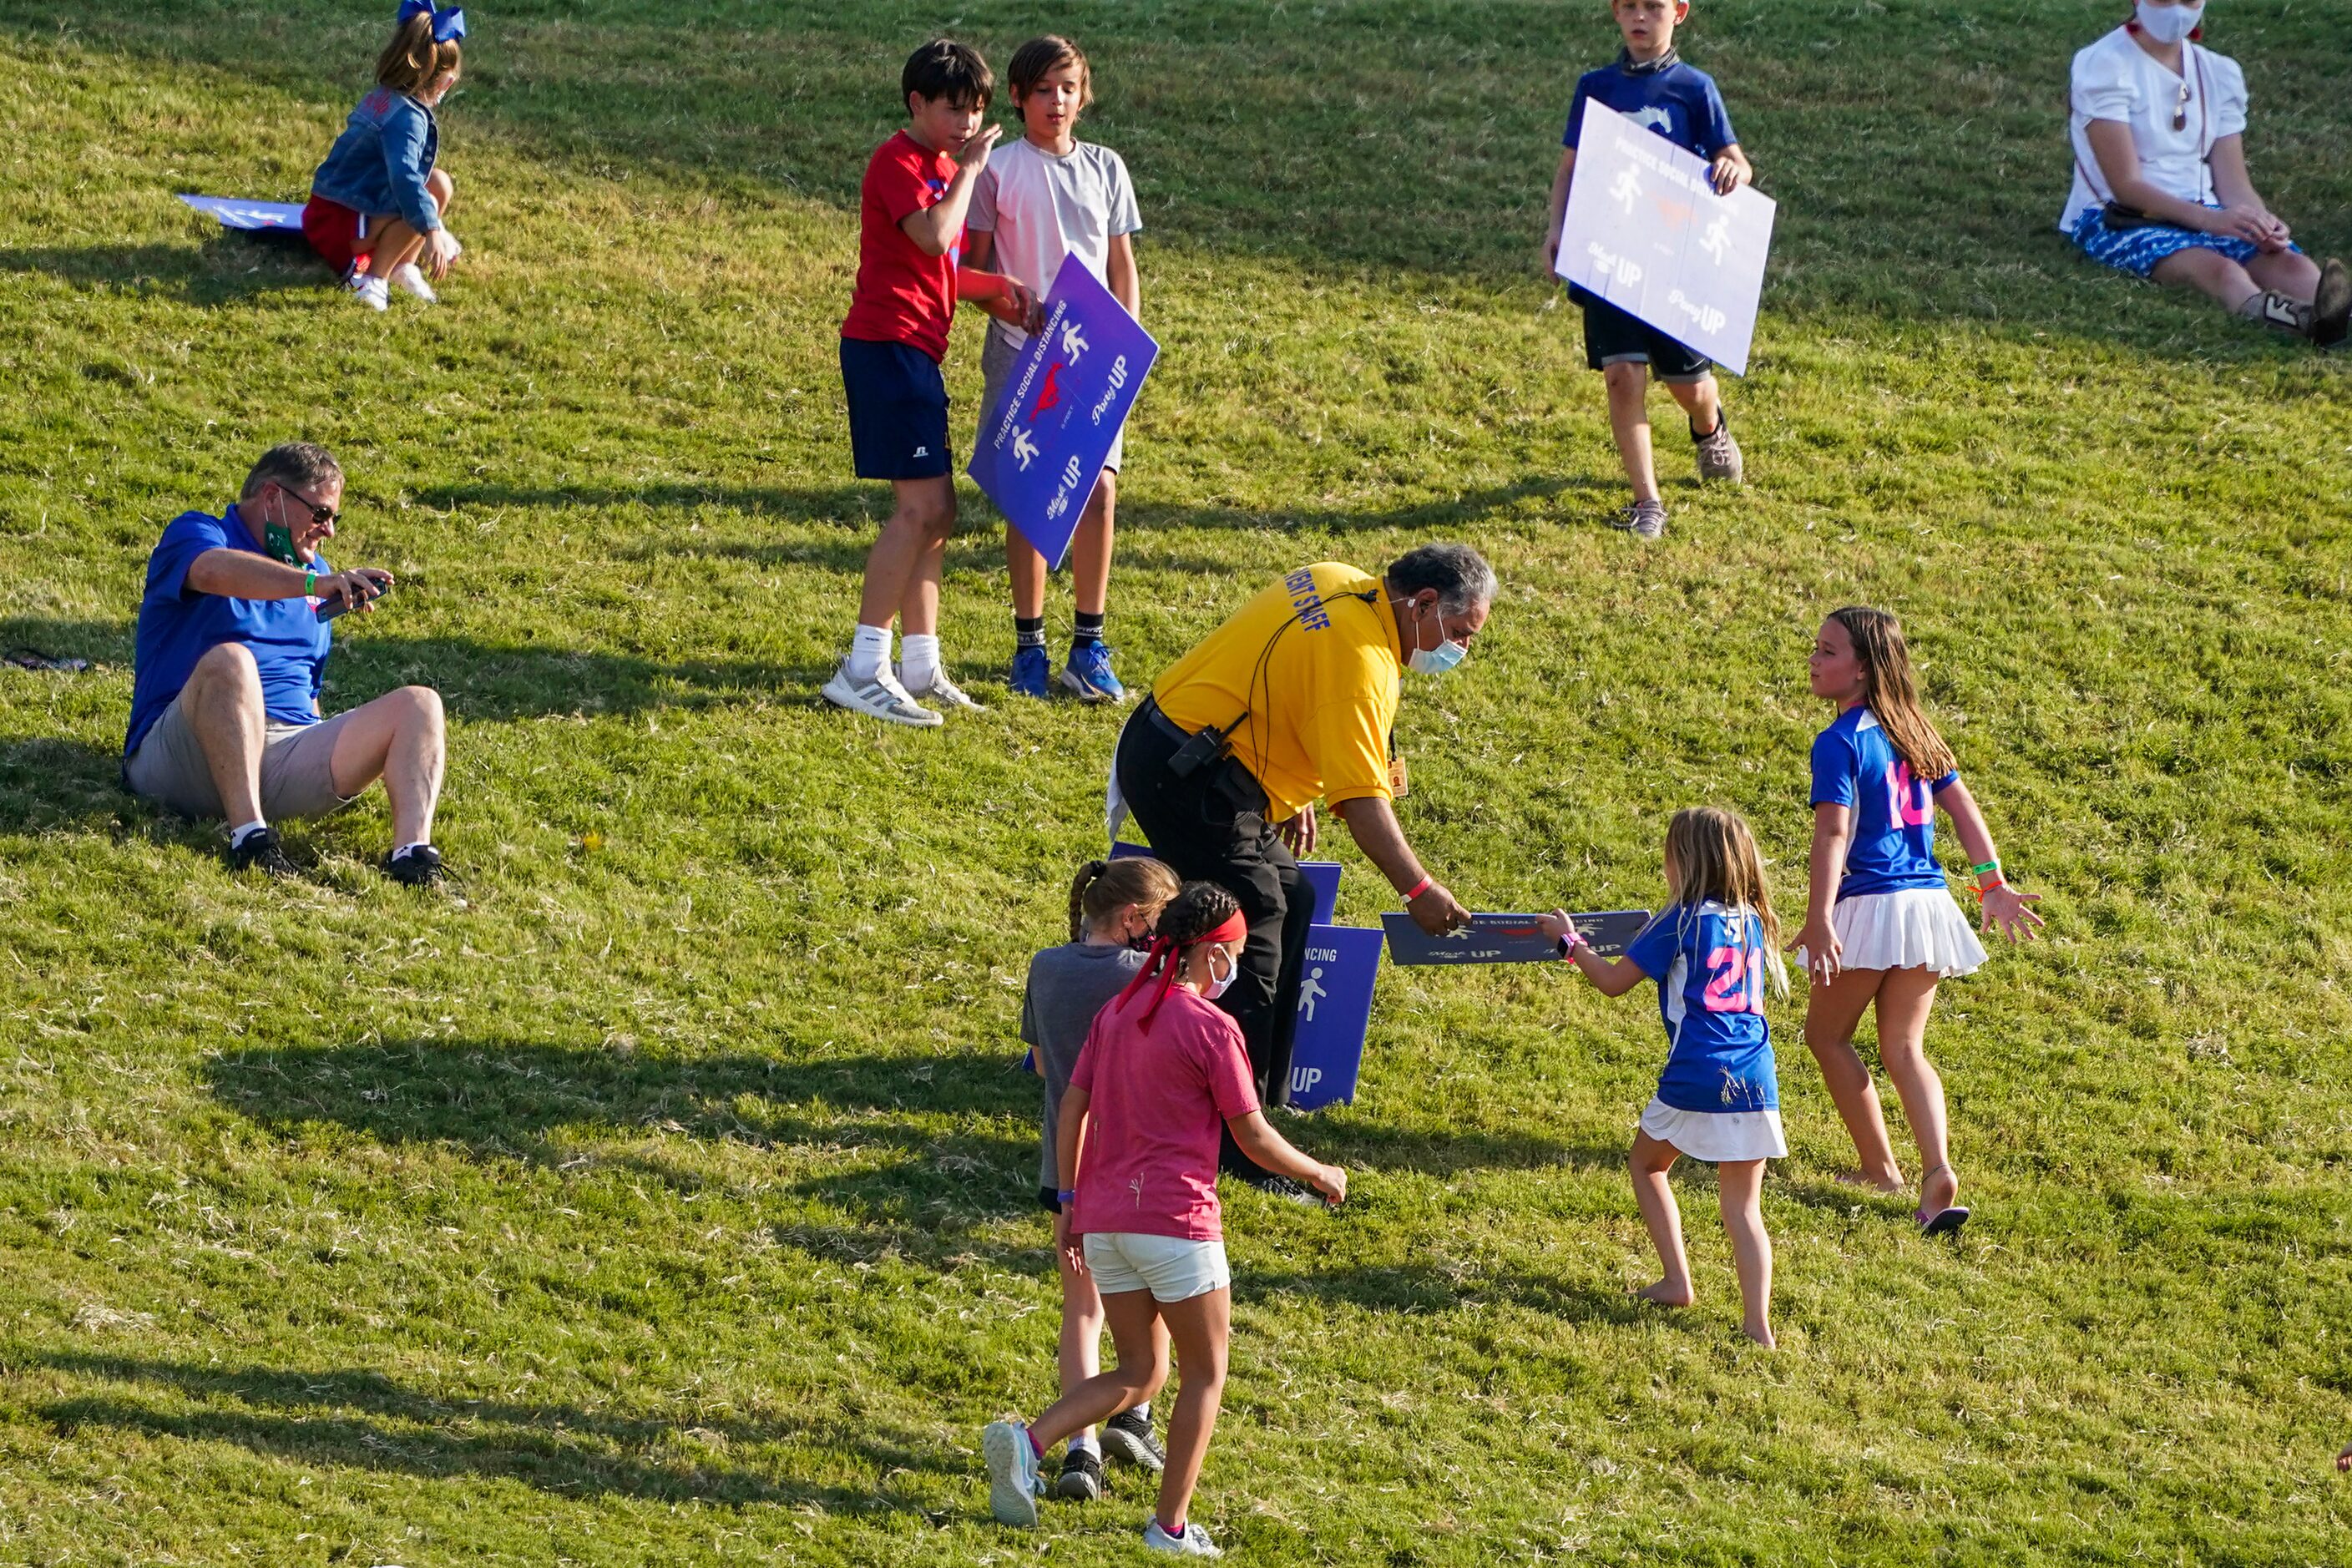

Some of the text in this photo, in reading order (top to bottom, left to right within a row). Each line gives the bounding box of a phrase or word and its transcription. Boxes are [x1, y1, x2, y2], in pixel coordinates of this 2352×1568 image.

[1616, 256, 1643, 289] UP
[1700, 303, 1726, 336] UP
[994, 299, 1068, 450] PRACTICE SOCIAL DISTANCING
[1091, 354, 1128, 427] Pony UP
[1046, 454, 1082, 520] Mask UP
[1283, 565, 1331, 632] VENT STAFF
[1885, 761, 1934, 830] 10
[1304, 947, 1338, 963] NCING
[1471, 949, 1502, 959] UP
[1590, 943, 1621, 953] UP
[1703, 946, 1764, 1016] 21
[1291, 1066, 1323, 1094] UP
